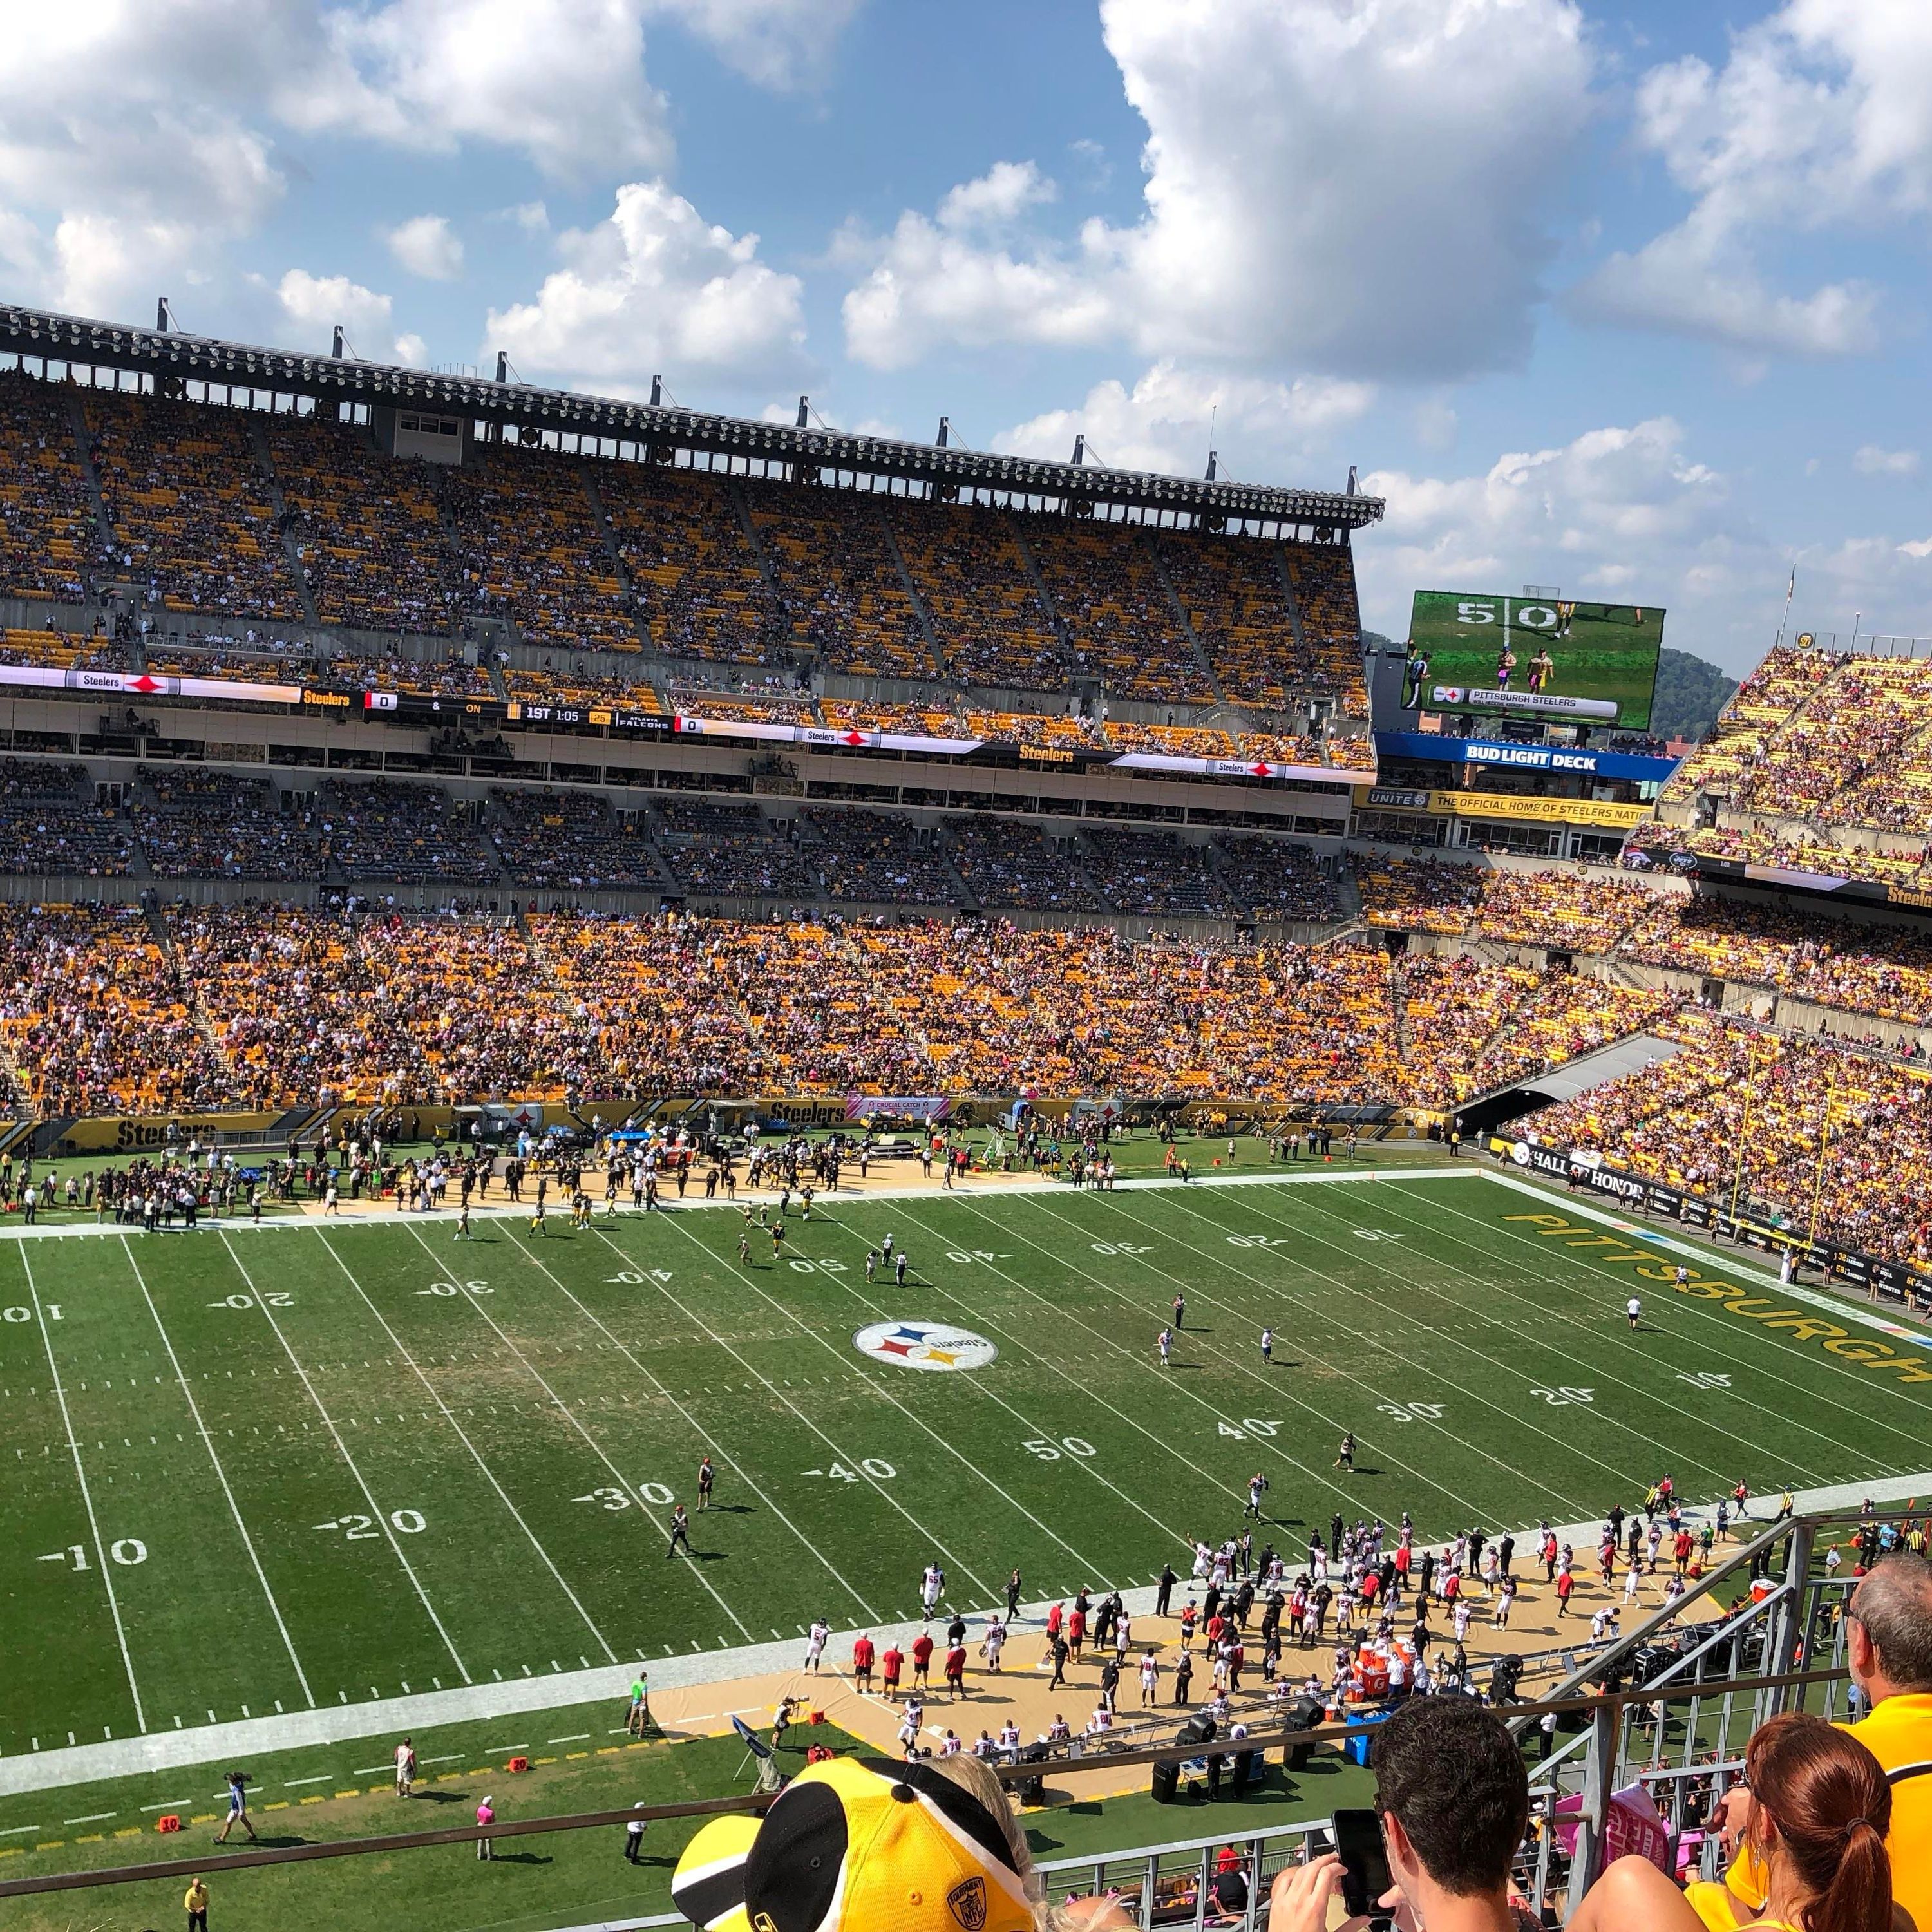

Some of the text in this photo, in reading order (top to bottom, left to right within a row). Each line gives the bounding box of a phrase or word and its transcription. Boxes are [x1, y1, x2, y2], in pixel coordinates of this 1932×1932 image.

[1799, 638, 1812, 647] 527
[84, 676, 120, 687] Steelers
[303, 690, 350, 706] Steelers
[380, 696, 388, 706] 0
[1473, 691, 1577, 708] PITTSBURGH STEELERS
[432, 702, 482, 714] & ON
[527, 707, 579, 722] 1ST 1:05
[594, 714, 606, 723] 25
[620, 719, 668, 730] FALCONS
[688, 721, 696, 730] 0
[808, 730, 835, 741] Steelers
[1019, 745, 1074, 762] Steelers
[1466, 746, 1596, 770] BUD LIGHT DECK
[1219, 762, 1244, 773] Steelers
[1370, 793, 1412, 805] UNITE
[1437, 797, 1457, 806] THE
[1460, 799, 1506, 810] OFFICIAL
[1510, 802, 1539, 812] HOME
[1542, 804, 1557, 813] OF
[1559, 805, 1612, 817] STEELERS
[772, 1101, 846, 1124] Steelers
[118, 1121, 216, 1146] Steeers
[1534, 1151, 1568, 1175] HALL
[1090, 1242, 1144, 1256] 30
[1226, 1235, 1282, 1248] 20
[945, 1249, 1005, 1264] 40
[1837, 1252, 1847, 1262] 32
[788, 1258, 849, 1273] 50
[1835, 1264, 1844, 1274] 58
[615, 1269, 674, 1285] 40
[430, 1280, 495, 1297] 30
[225, 1292, 295, 1309] 20
[3, 1304, 66, 1323] 10
[931, 1339, 988, 1349] Steelers
[1675, 1371, 1732, 1390] 10
[1530, 1386, 1594, 1406] 20
[1376, 1401, 1444, 1423] 30
[1217, 1417, 1279, 1441] 40
[1021, 1437, 1097, 1461] 50
[828, 1457, 897, 1484] 40
[592, 1482, 676, 1511] 30
[338, 1509, 427, 1540] 20
[67, 1538, 148, 1572] 10
[928, 1575, 938, 1584] 65
[813, 1631, 820, 1641] 5
[1374, 1676, 1385, 1690] G
[513, 1759, 526, 1770] 20
[164, 1818, 177, 1831] 10
[949, 1880, 983, 1906] EQUIPMENT
[964, 1907, 983, 1925] NFL
